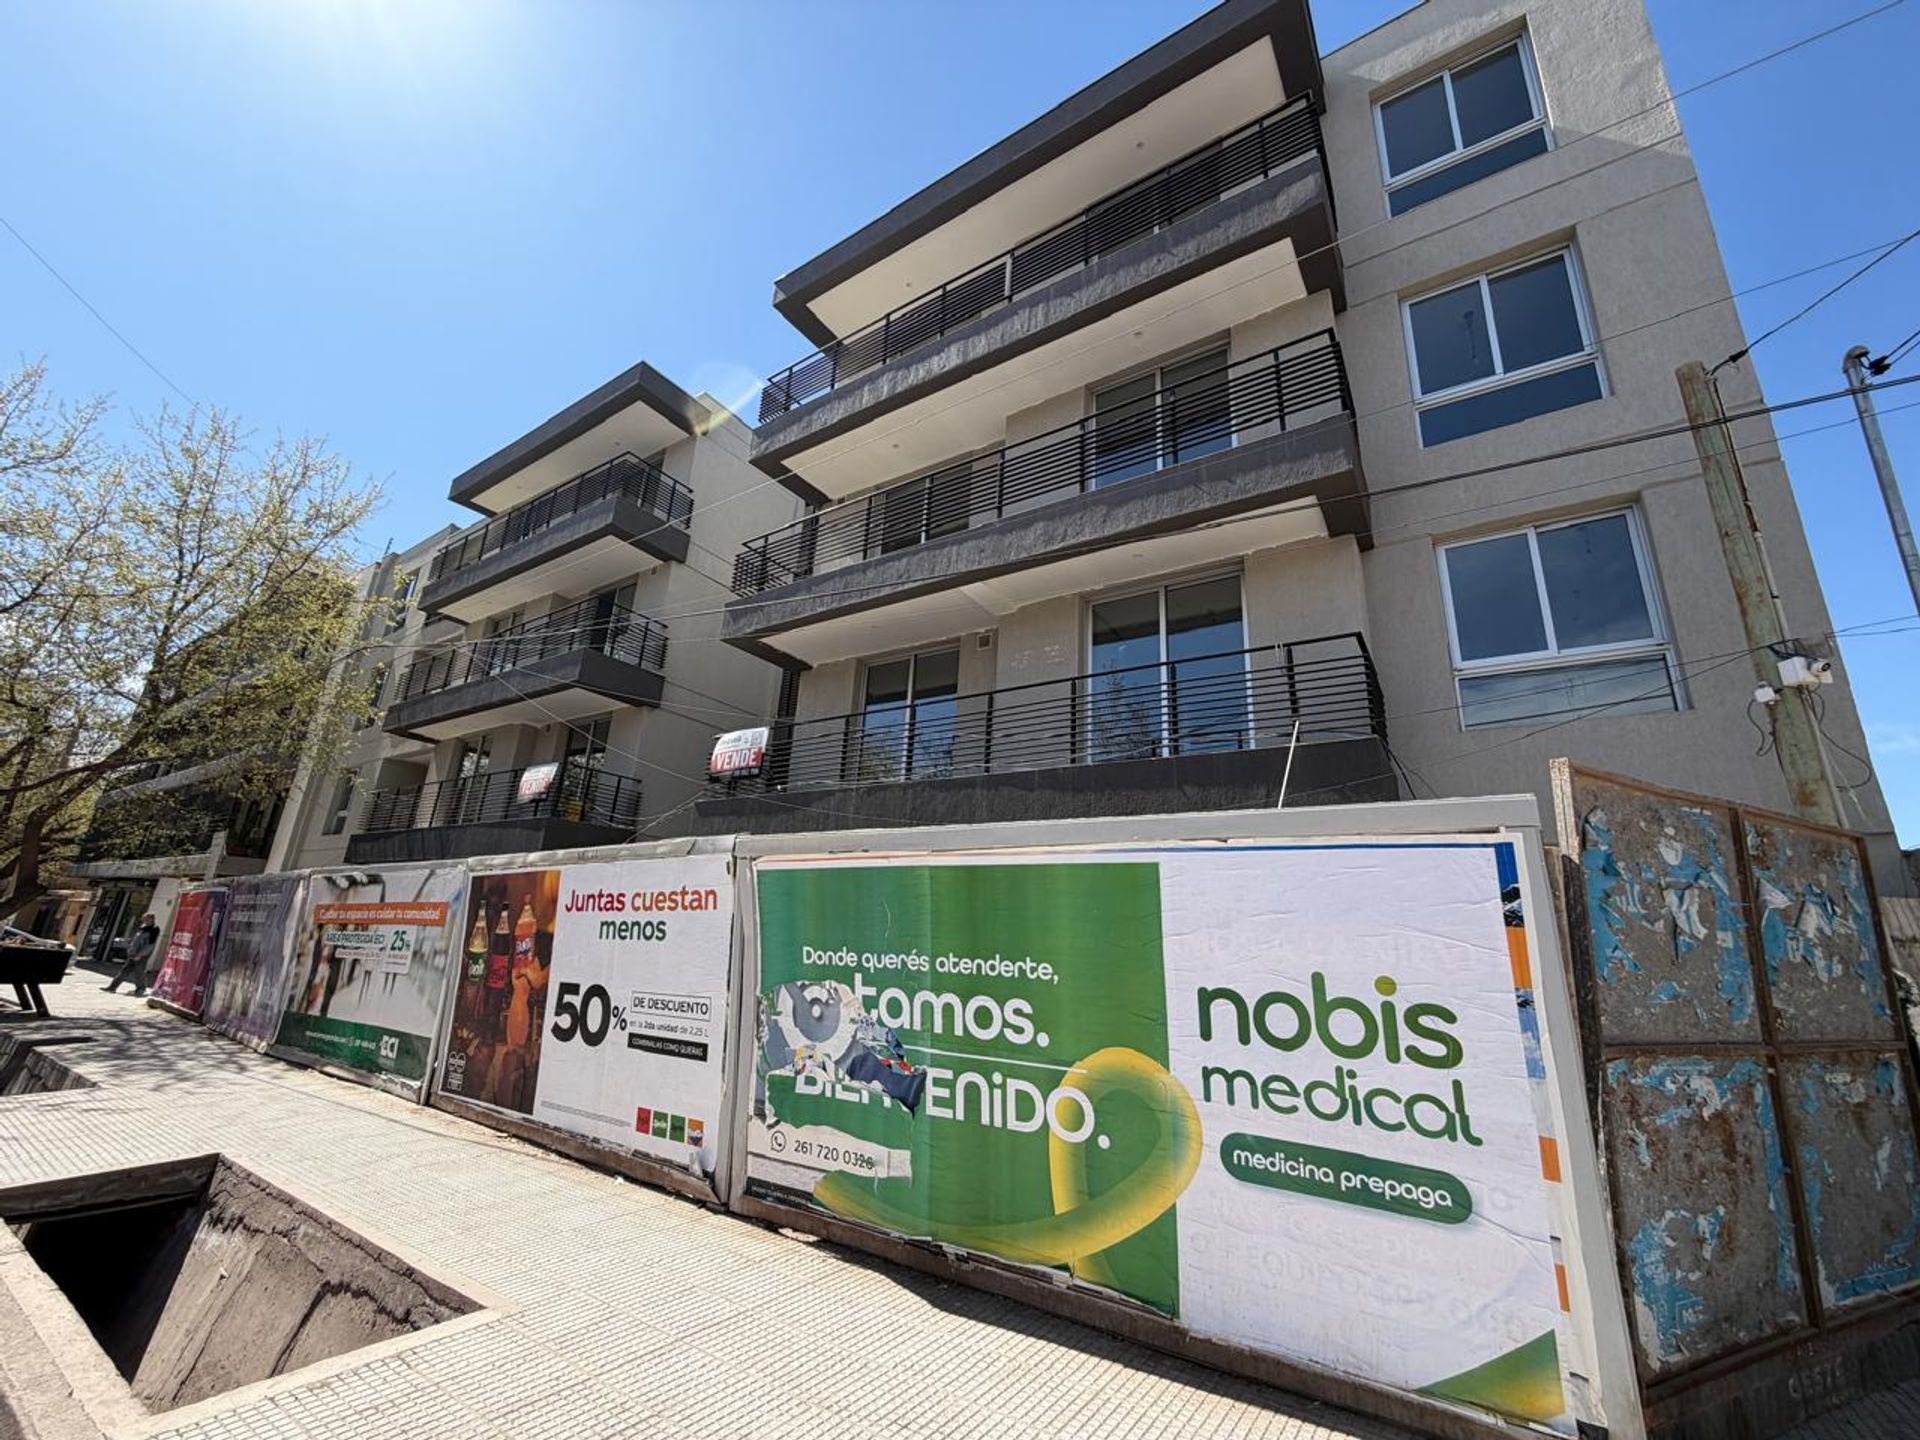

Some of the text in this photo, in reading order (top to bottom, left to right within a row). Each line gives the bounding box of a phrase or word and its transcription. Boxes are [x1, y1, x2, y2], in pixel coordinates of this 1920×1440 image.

[716, 748, 758, 770] VENDE
[565, 885, 718, 912] Juntas cuestan
[598, 919, 667, 941] menos
[803, 946, 1058, 985] Donde querés atenderte,
[551, 981, 627, 1047] 50%
[633, 996, 709, 1015] DE DESCUENTO
[656, 1023, 678, 1033] unidad
[1197, 971, 1463, 1069] nobis
[1201, 1065, 1483, 1147] medical
[794, 1139, 813, 1156] 261
[817, 1143, 839, 1162] 720
[1233, 1147, 1452, 1209] medicina prepaga
